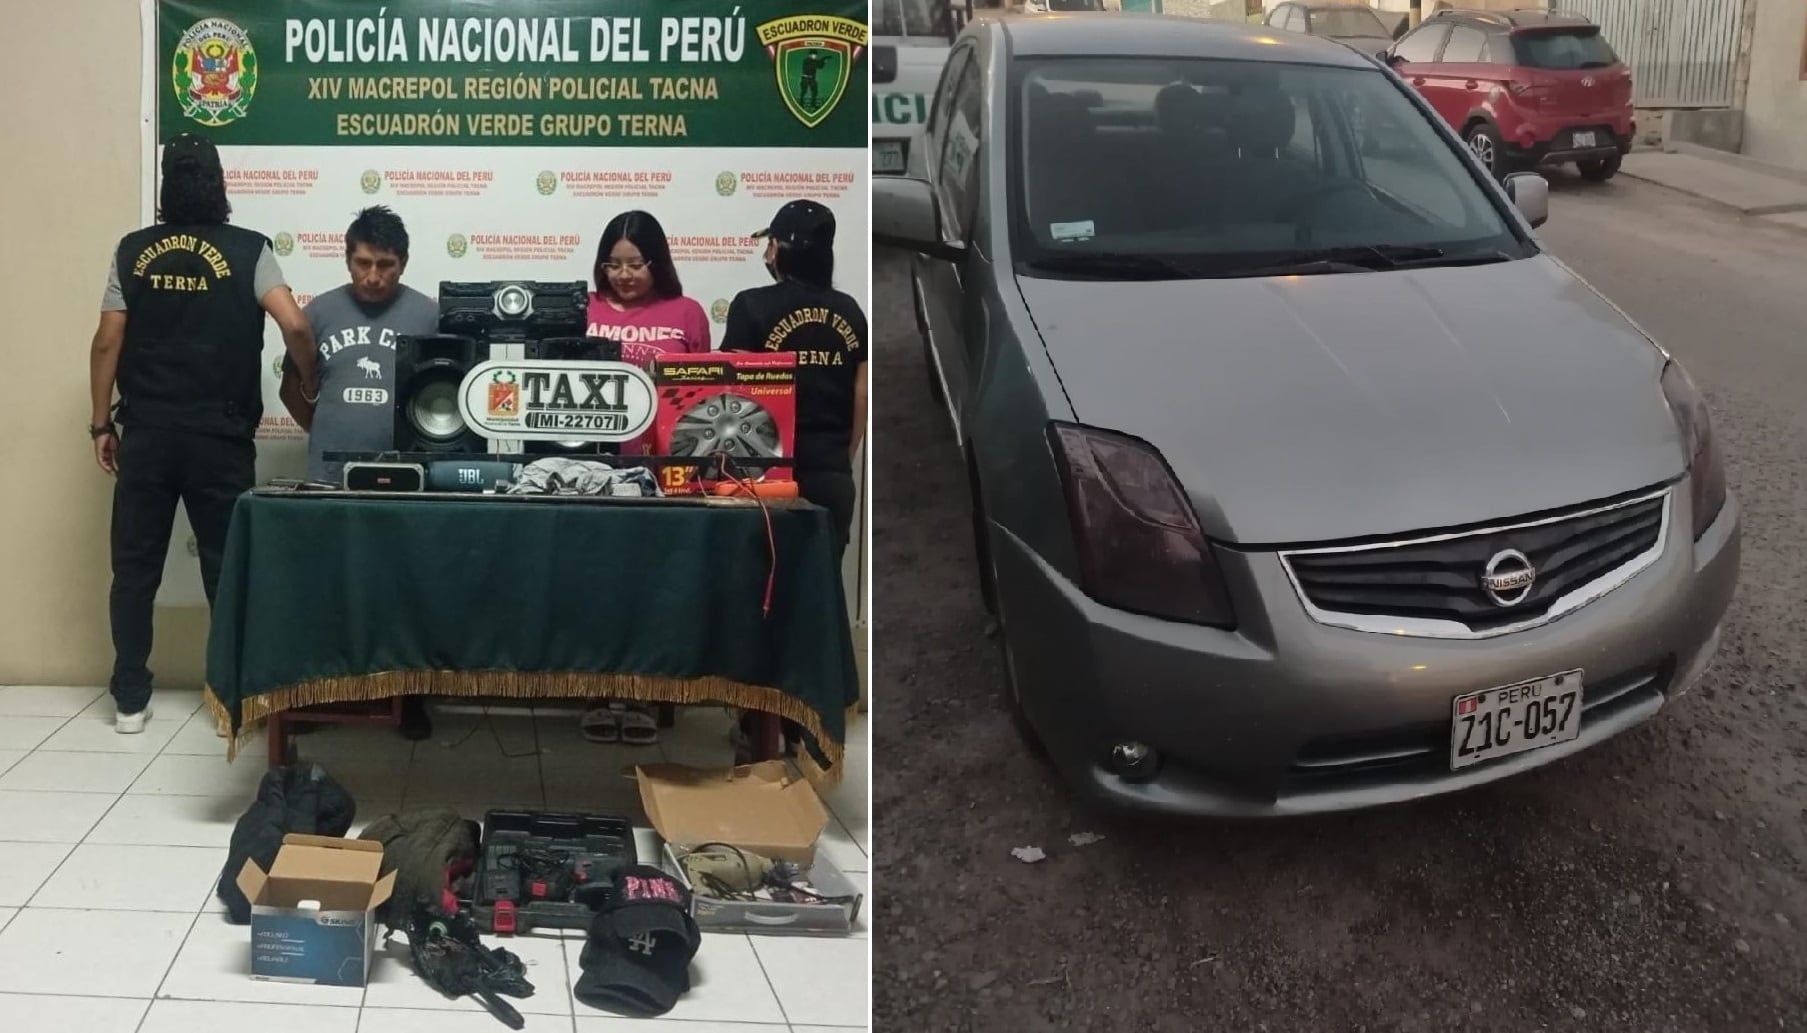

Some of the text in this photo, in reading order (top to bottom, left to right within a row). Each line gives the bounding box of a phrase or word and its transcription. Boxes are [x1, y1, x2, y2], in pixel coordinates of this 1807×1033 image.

[286, 6, 746, 63] POLICÍA NACIONAL DEL PERÚ
[762, 20, 868, 42] ESCUADRON VERDE
[308, 72, 719, 99] XIV MACREPOL REGIÓN POLICIAL TACNA
[336, 109, 688, 136] ESCUADRÓN VERDE GRUPO TERNA
[282, 170, 297, 180] DEL
[456, 170, 471, 181] DEL
[634, 171, 649, 182] DEL
[815, 172, 831, 183] DEL
[543, 235, 558, 245] DEL
[722, 236, 737, 247] DEL
[133, 234, 232, 279] ESCUADRON VERDE
[150, 274, 208, 292] TERNA
[586, 322, 686, 342] AMONES
[764, 307, 860, 352] ESCUADRON VERDE
[319, 326, 371, 361] PARK
[798, 350, 843, 366] ERNA
[663, 366, 724, 376] SAFARI
[736, 372, 754, 381] Tapa
[765, 372, 793, 381] Ruedas
[348, 389, 384, 403] 1963
[522, 372, 630, 412] TAXI
[750, 386, 793, 396] Universal
[539, 413, 613, 430] MI-22707
[458, 468, 485, 485] JBL
[1490, 573, 1535, 589] NISSAN
[1499, 683, 1543, 704] PERU
[1457, 691, 1577, 758] Z1C-057
